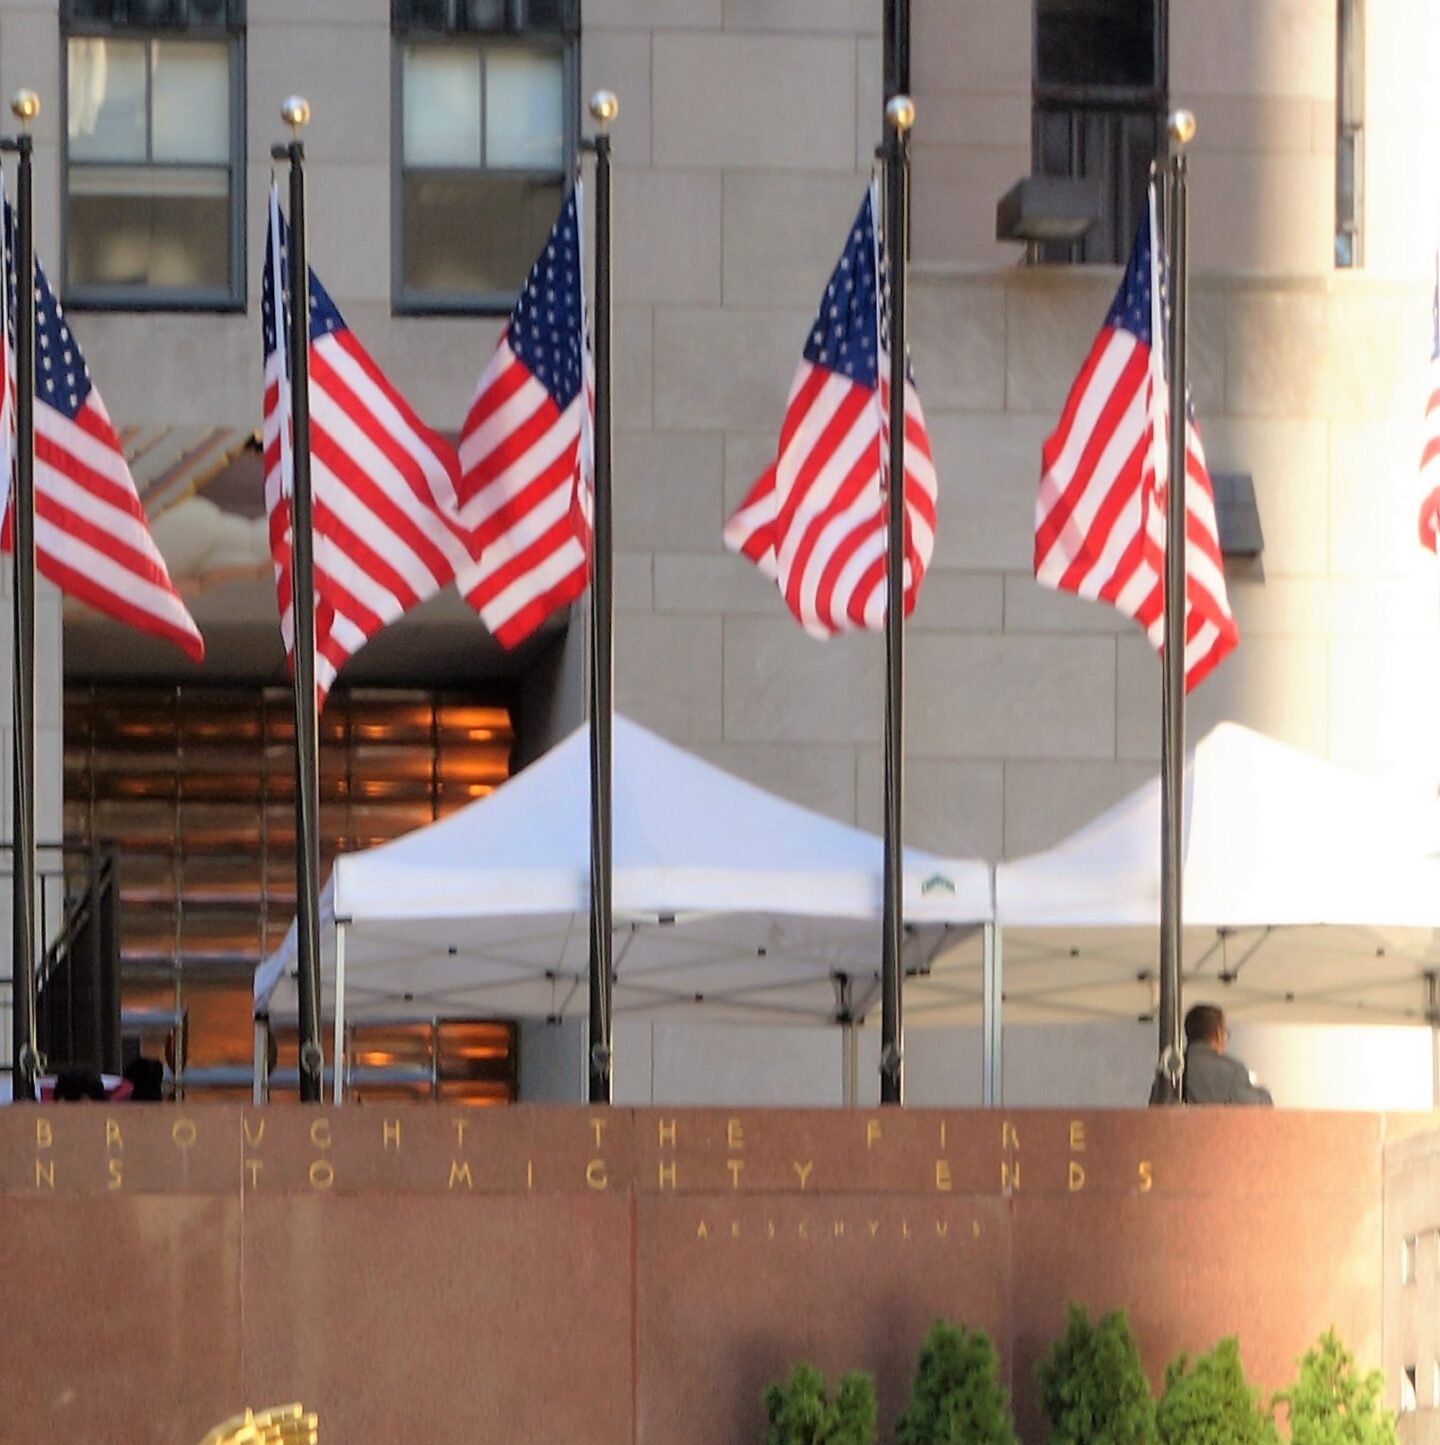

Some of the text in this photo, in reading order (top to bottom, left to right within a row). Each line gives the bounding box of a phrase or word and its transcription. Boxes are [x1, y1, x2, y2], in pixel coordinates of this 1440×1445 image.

[35, 1116, 469, 1151] BROUGHT
[590, 1117, 744, 1150] THE
[867, 1118, 1086, 1152] FIRE
[245, 1158, 335, 1191] TO
[448, 1158, 814, 1191] MIGHTY
[935, 1159, 1153, 1193] ENDS
